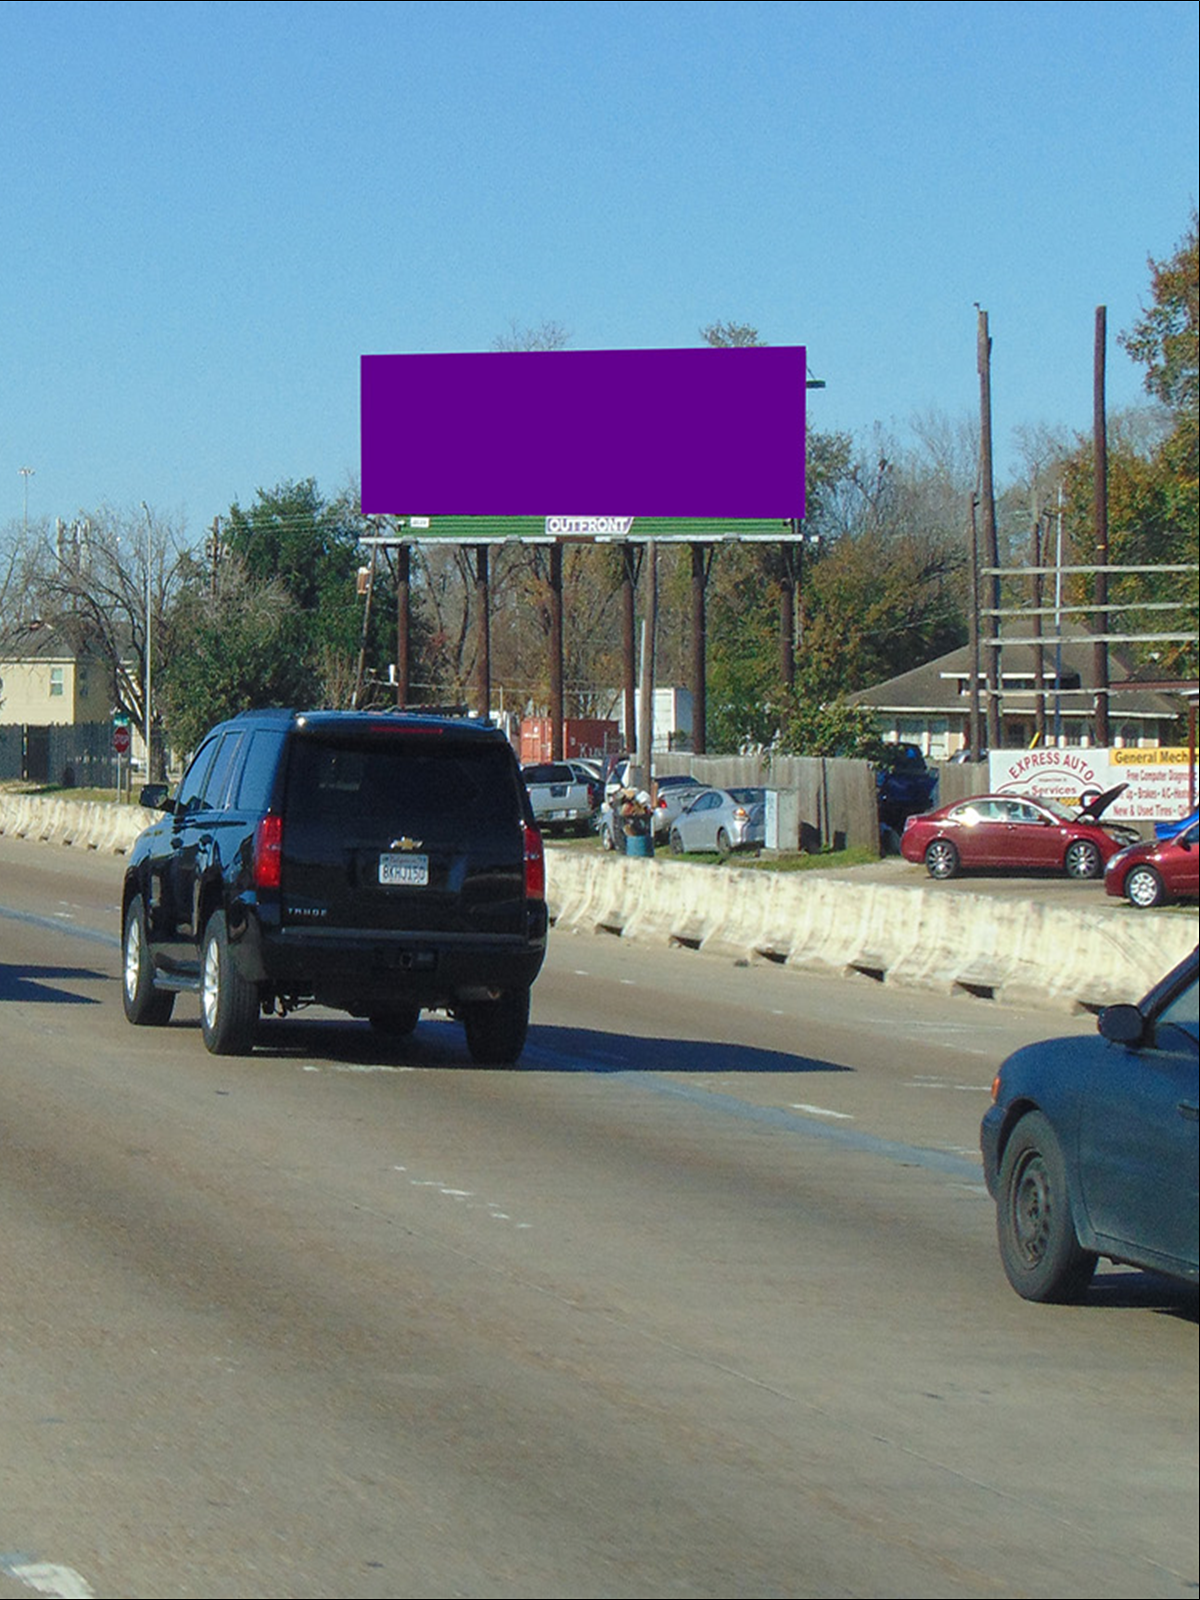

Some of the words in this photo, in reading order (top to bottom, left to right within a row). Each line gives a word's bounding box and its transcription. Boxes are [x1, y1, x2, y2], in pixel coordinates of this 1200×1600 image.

[548, 518, 629, 532] OUTFRONT
[1115, 751, 1157, 763] General
[1009, 752, 1060, 779] EXPRESS
[1063, 754, 1095, 781] AUTO
[1032, 786, 1076, 796] Services
